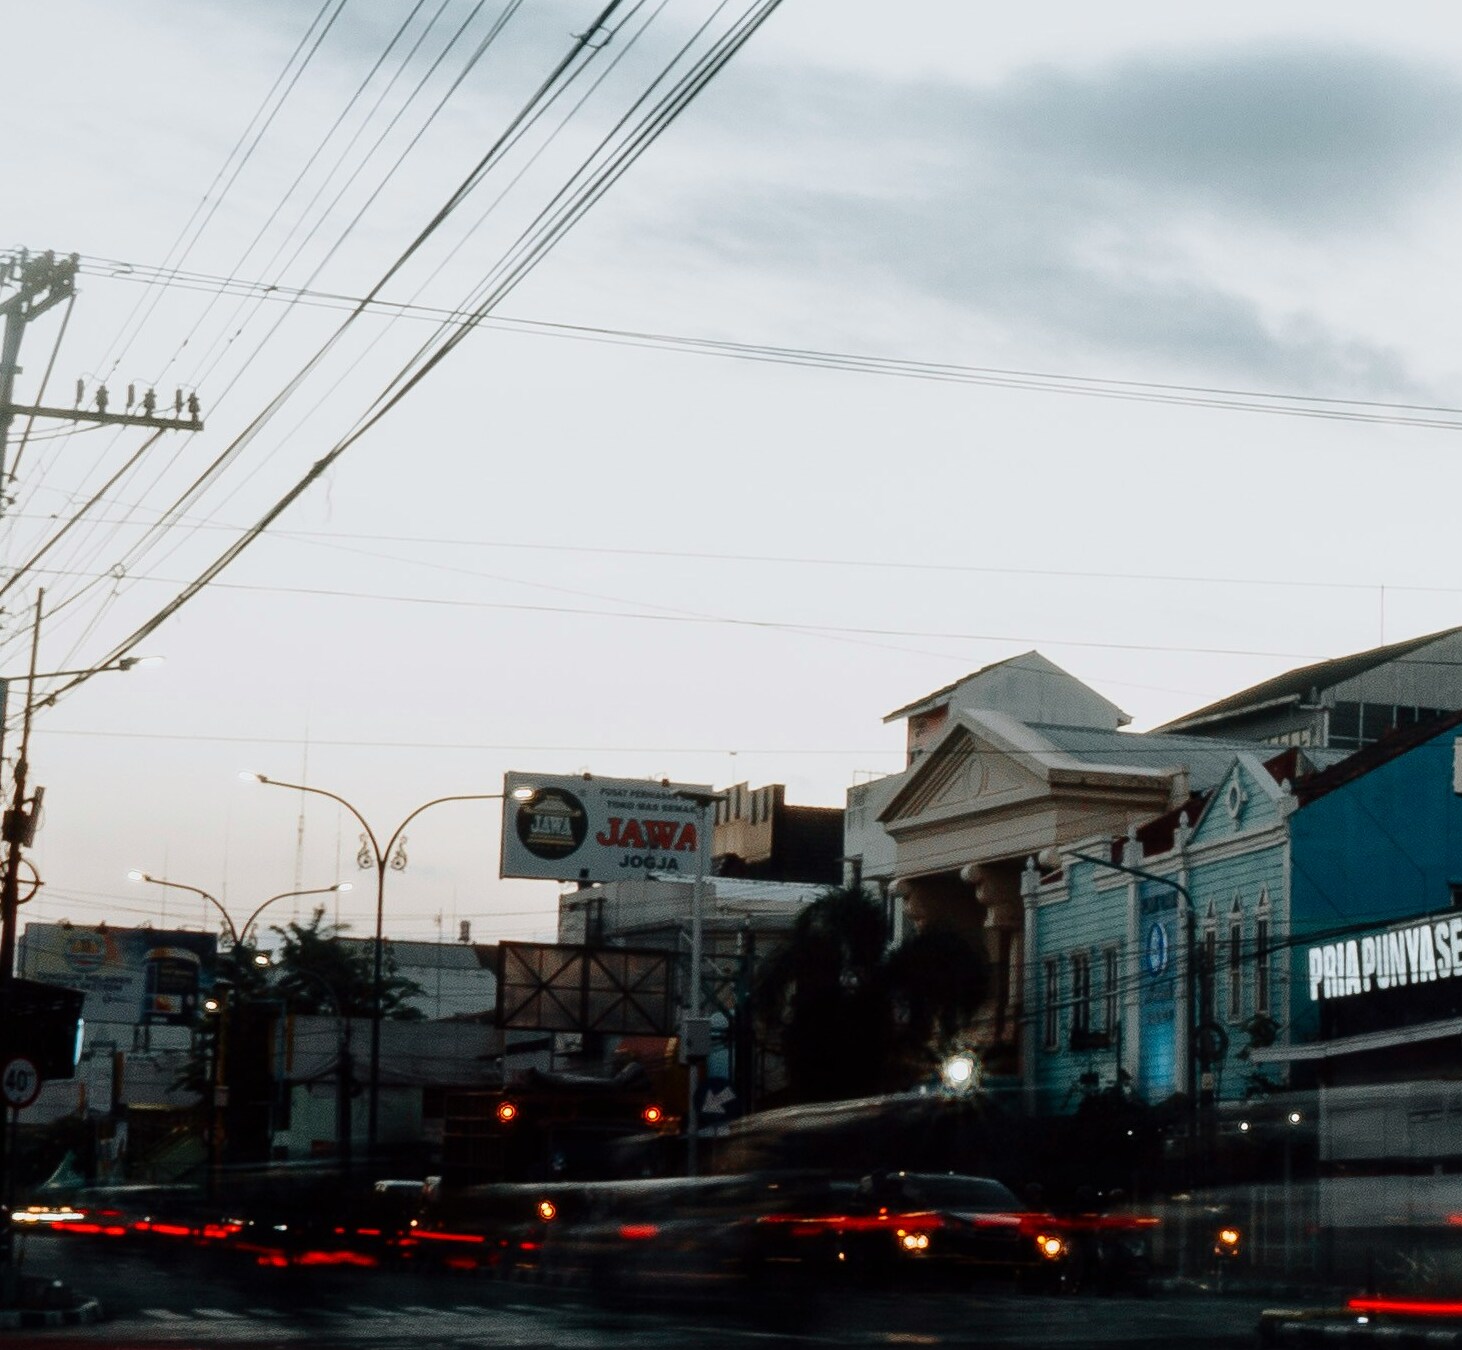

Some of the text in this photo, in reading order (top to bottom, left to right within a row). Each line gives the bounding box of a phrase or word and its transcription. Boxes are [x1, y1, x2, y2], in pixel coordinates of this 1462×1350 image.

[530, 815, 571, 836] JAWA
[596, 816, 698, 852] JAWA
[619, 854, 679, 871] JOGJA
[1308, 939, 1362, 1002] PRIA
[1361, 924, 1437, 993] PUNYA
[5, 1069, 28, 1092] 40
